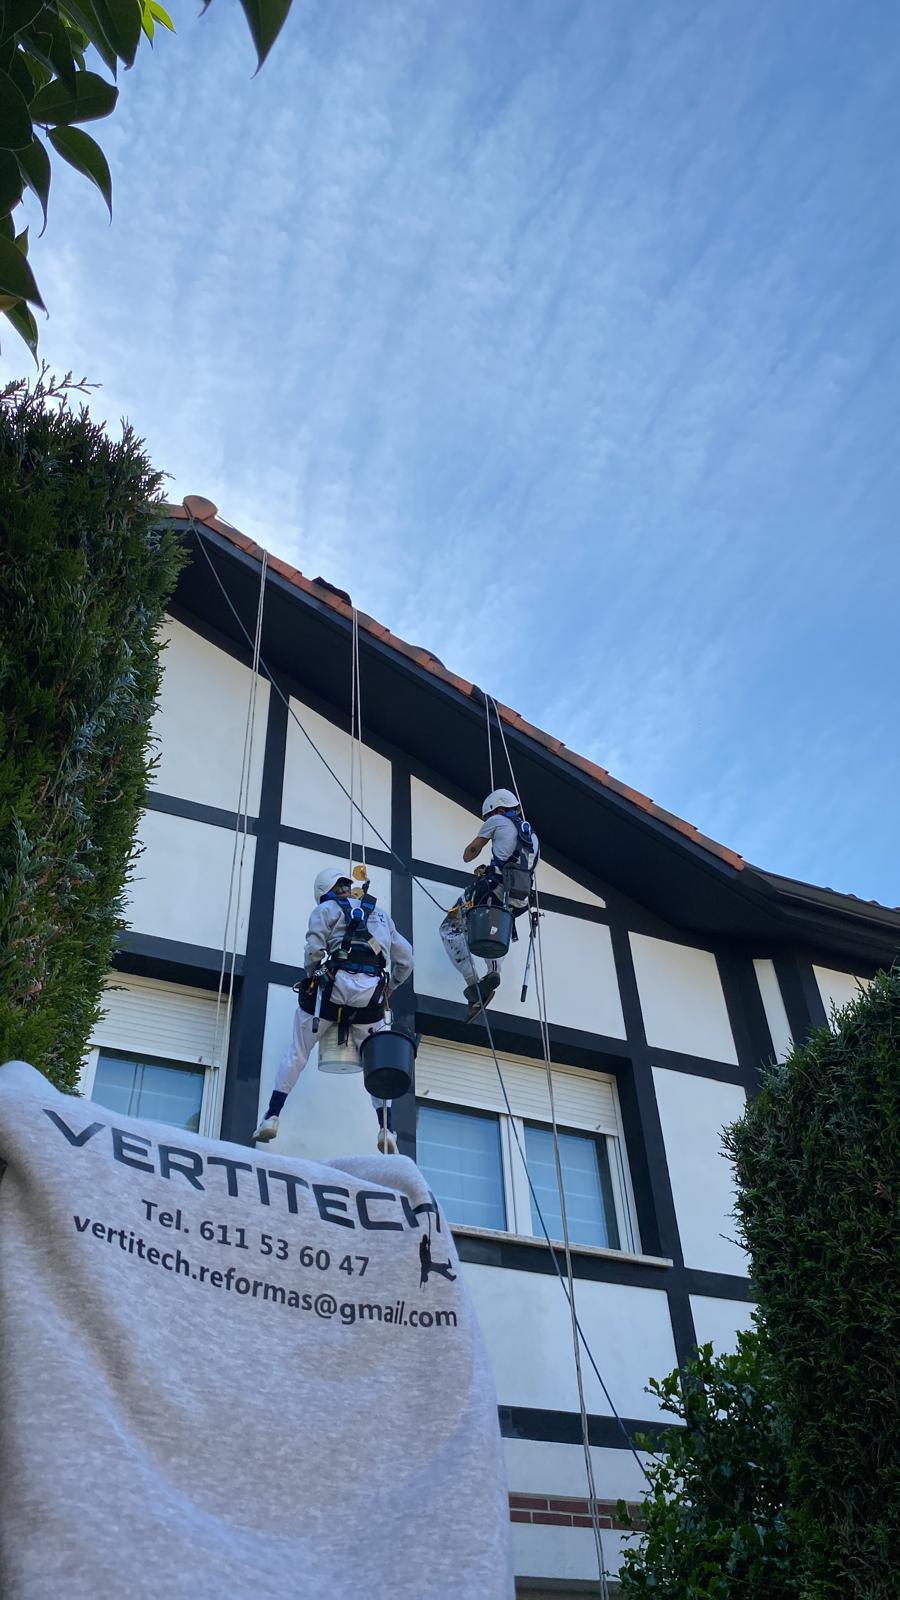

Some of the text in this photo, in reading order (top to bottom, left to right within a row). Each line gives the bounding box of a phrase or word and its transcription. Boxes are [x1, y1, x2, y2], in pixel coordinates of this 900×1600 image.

[42, 1108, 441, 1233] VERTITECH
[73, 1215, 457, 1328] vertitech.reformas@gmail.com
[141, 1199, 369, 1277] Tel. 611 53 60 47
